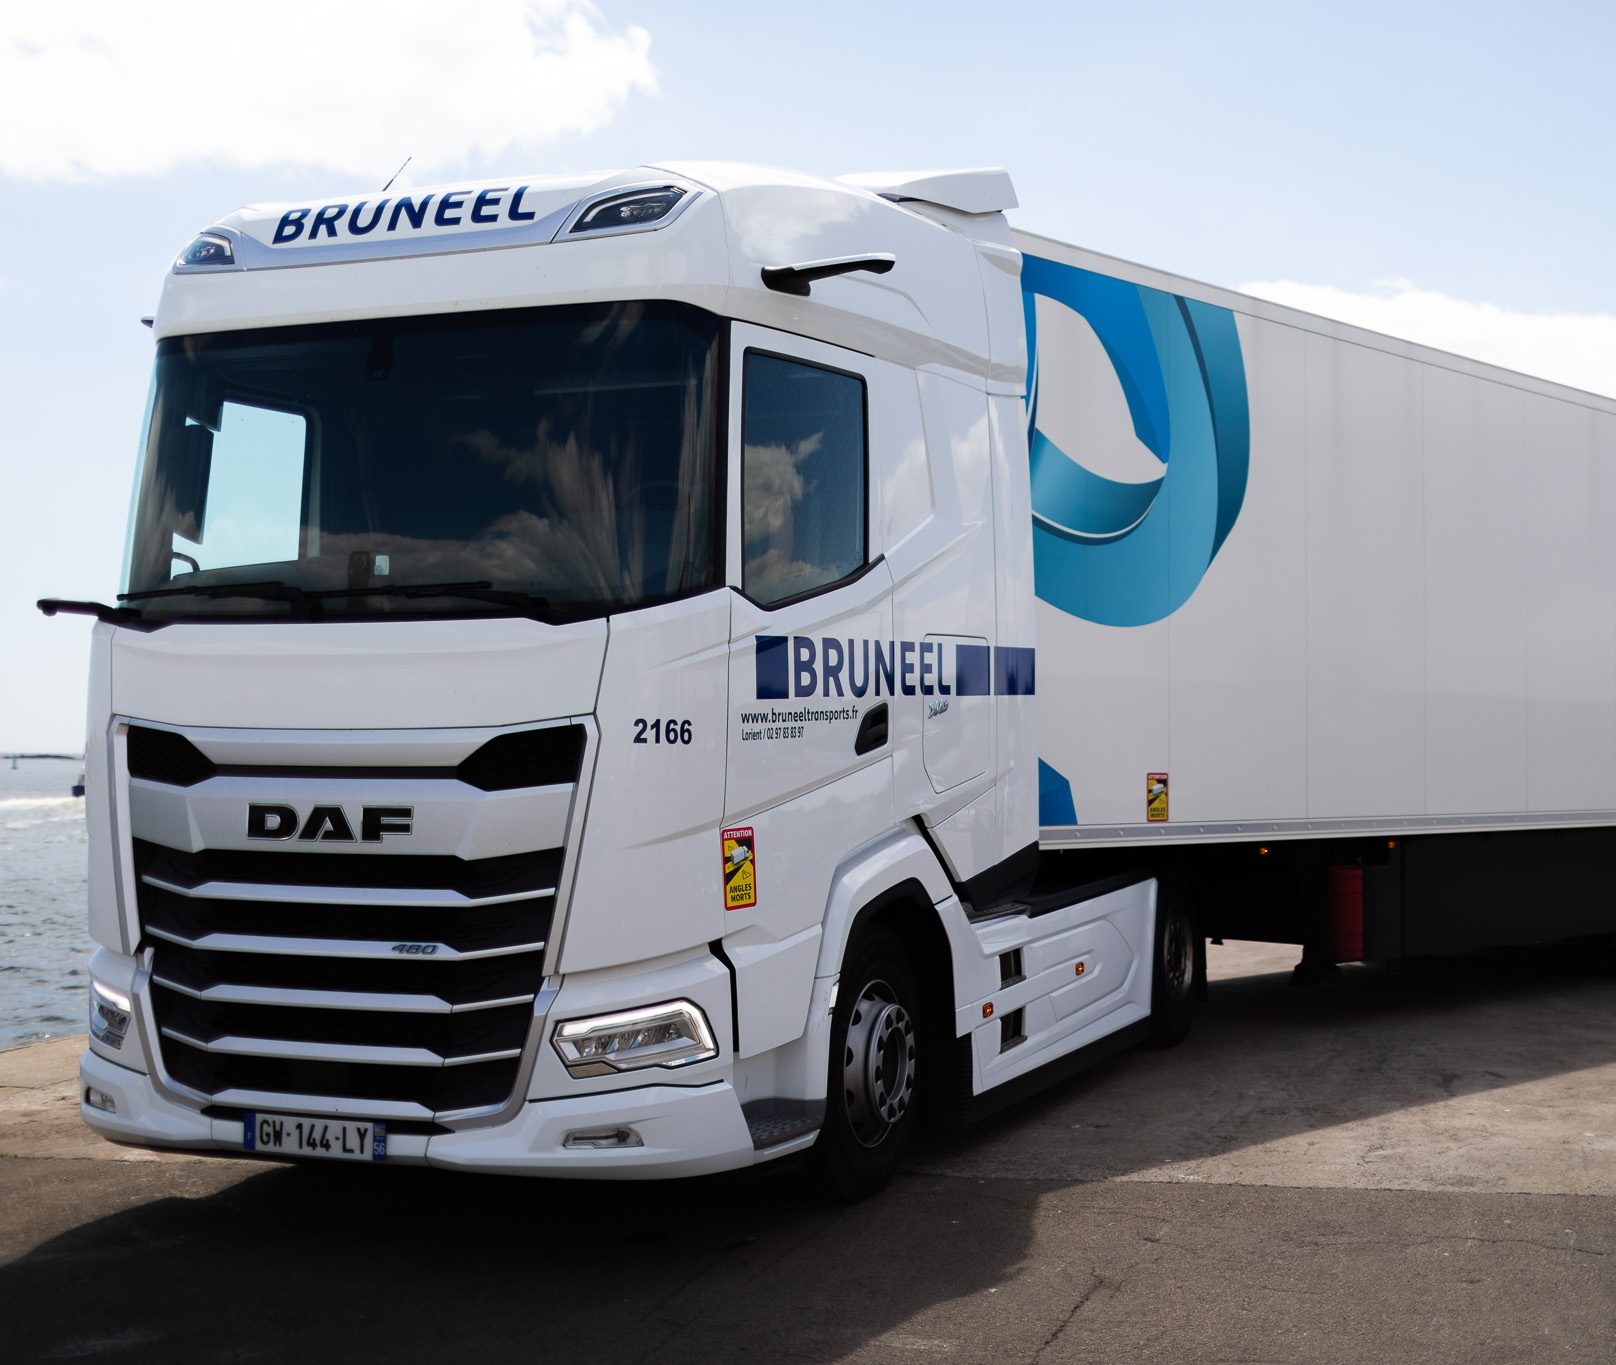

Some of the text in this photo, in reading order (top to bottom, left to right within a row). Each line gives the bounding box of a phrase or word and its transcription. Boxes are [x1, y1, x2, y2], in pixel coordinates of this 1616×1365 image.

[272, 186, 536, 245] BRUNEEL
[793, 635, 951, 698] BRUNEEL
[741, 705, 858, 724] www.bruneeltransports.fr
[633, 718, 692, 745] 2166
[741, 728, 762, 741] Lorient
[766, 727, 774, 740] 02
[775, 727, 782, 740] 97
[247, 802, 414, 843] DAF
[723, 830, 752, 839] ATTENTION
[729, 883, 752, 893] ANGLES
[730, 892, 752, 902] MORTS
[391, 943, 439, 956] 480
[259, 1119, 368, 1154] GW-144-LY
[374, 1142, 385, 1155] 56
